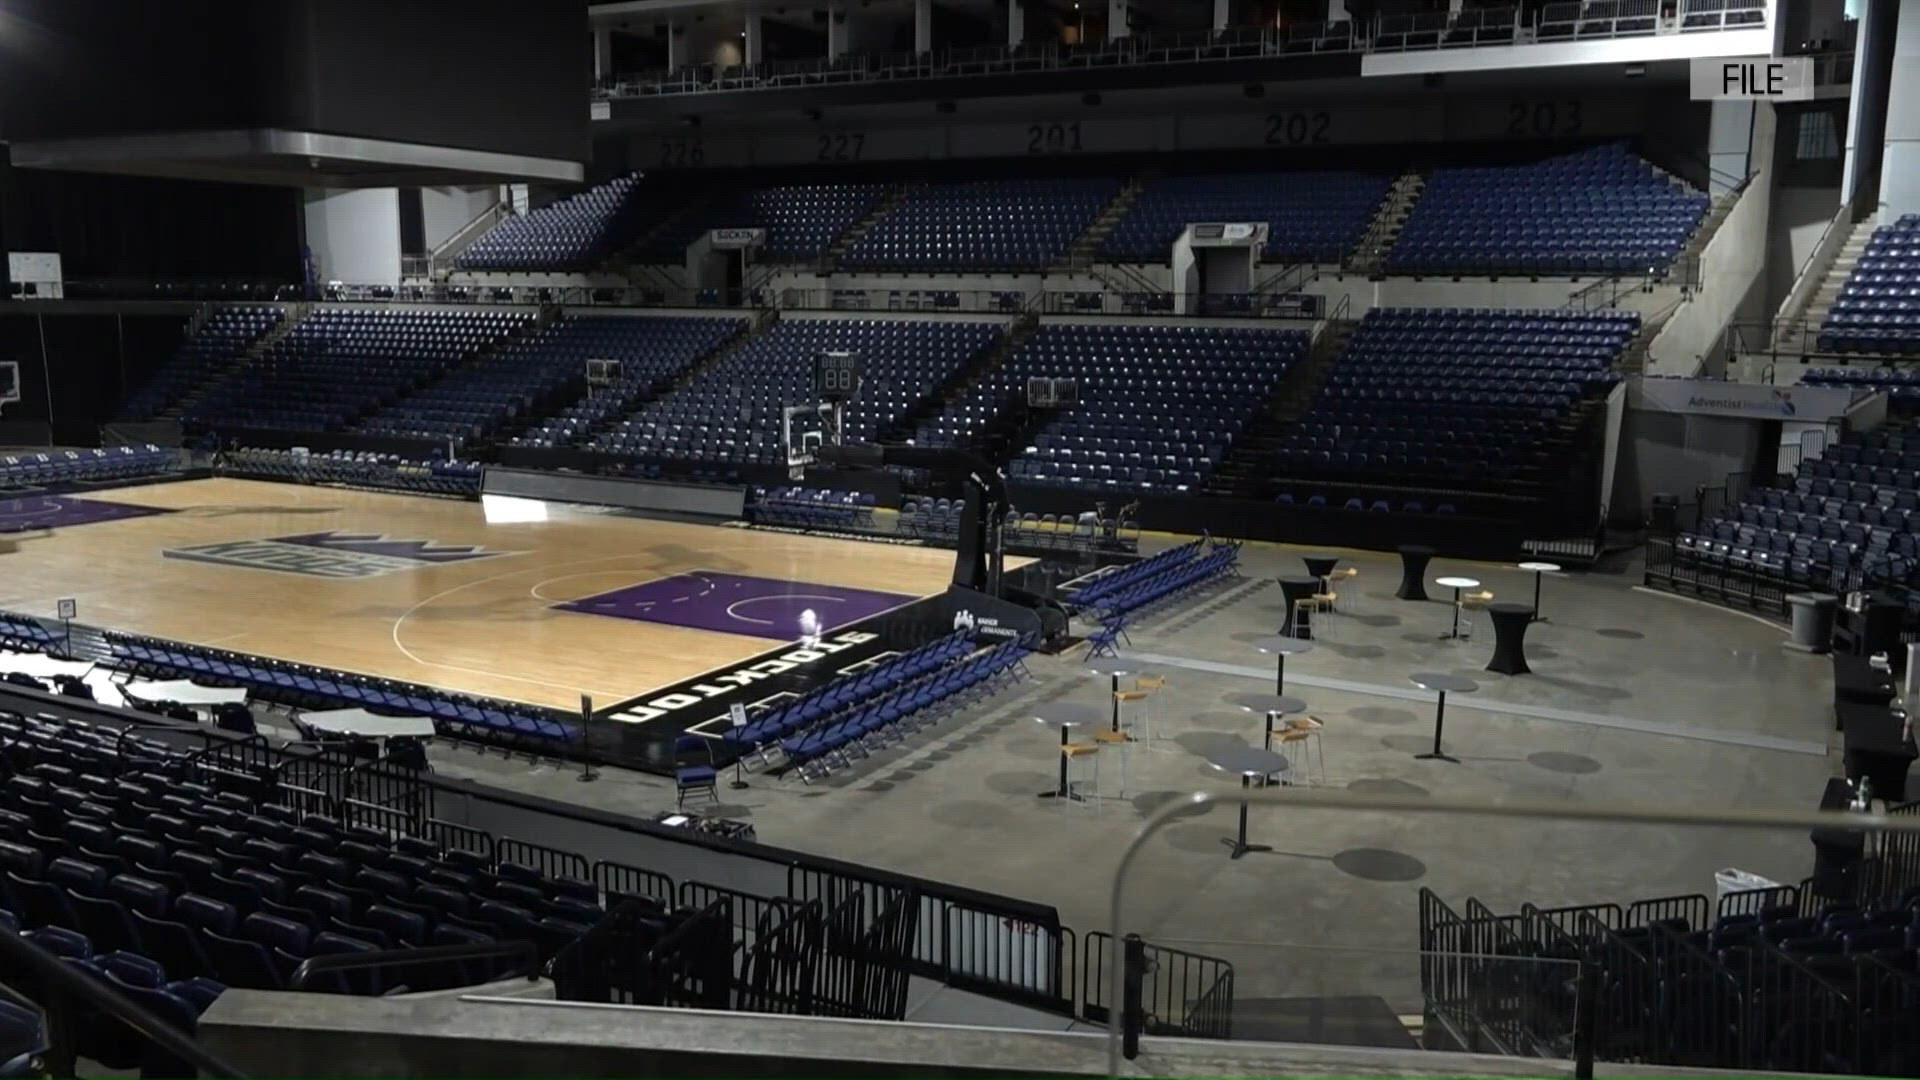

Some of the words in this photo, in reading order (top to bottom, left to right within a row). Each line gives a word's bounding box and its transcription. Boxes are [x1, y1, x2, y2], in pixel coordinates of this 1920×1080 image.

[1264, 111, 1330, 144] 202
[1507, 101, 1584, 136] 203
[817, 133, 865, 161] 227
[1028, 124, 1083, 153] 201
[1688, 397, 1742, 410] Adventist
[608, 631, 879, 724] STOCKTON
